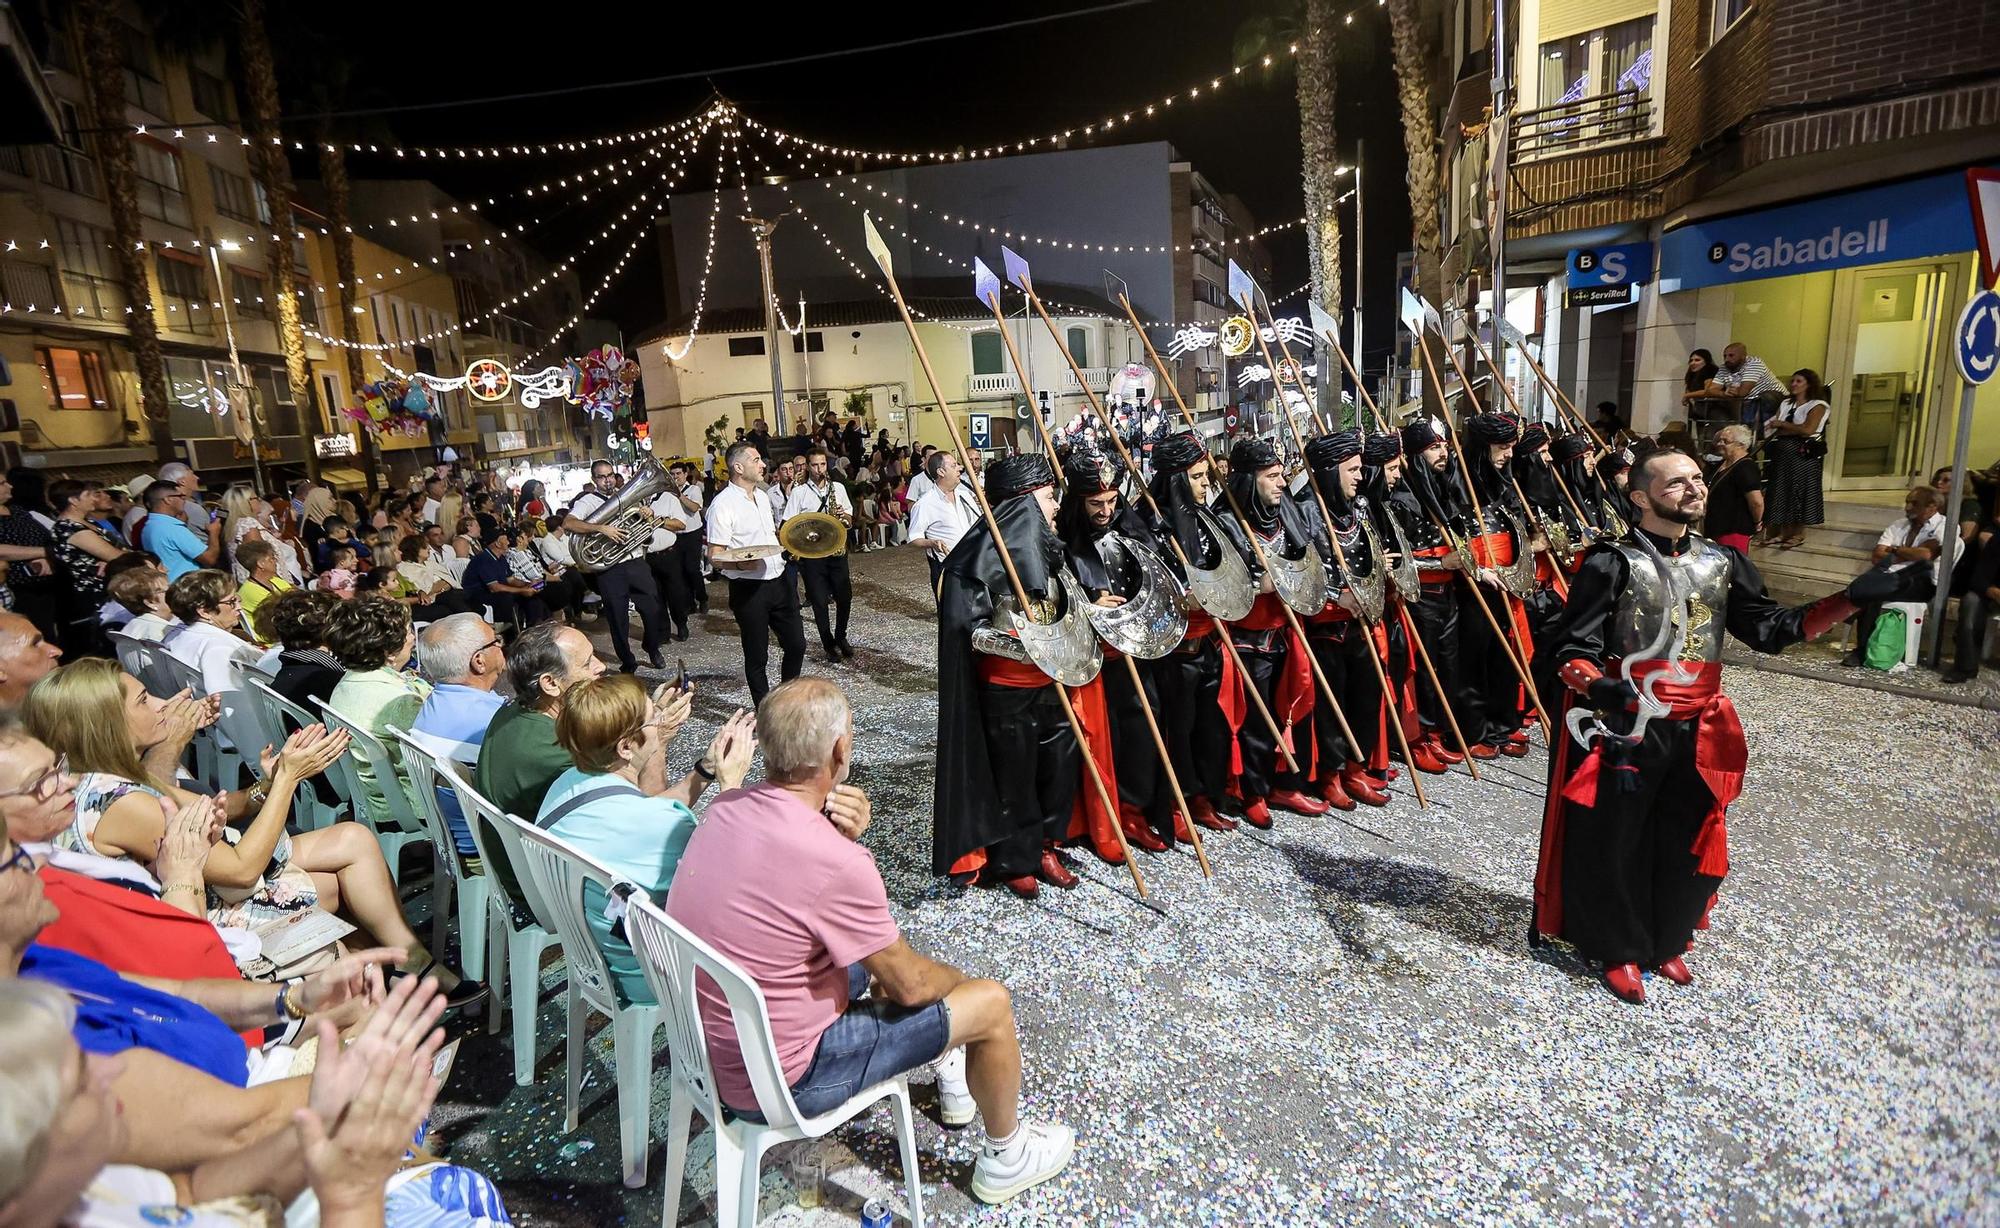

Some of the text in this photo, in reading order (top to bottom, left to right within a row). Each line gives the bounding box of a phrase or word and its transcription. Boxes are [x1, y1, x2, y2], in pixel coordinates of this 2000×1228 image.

[1713, 218, 1889, 273] B Sabadell
[1580, 251, 1627, 284] B S
[1590, 289, 1627, 300] ServiRed
